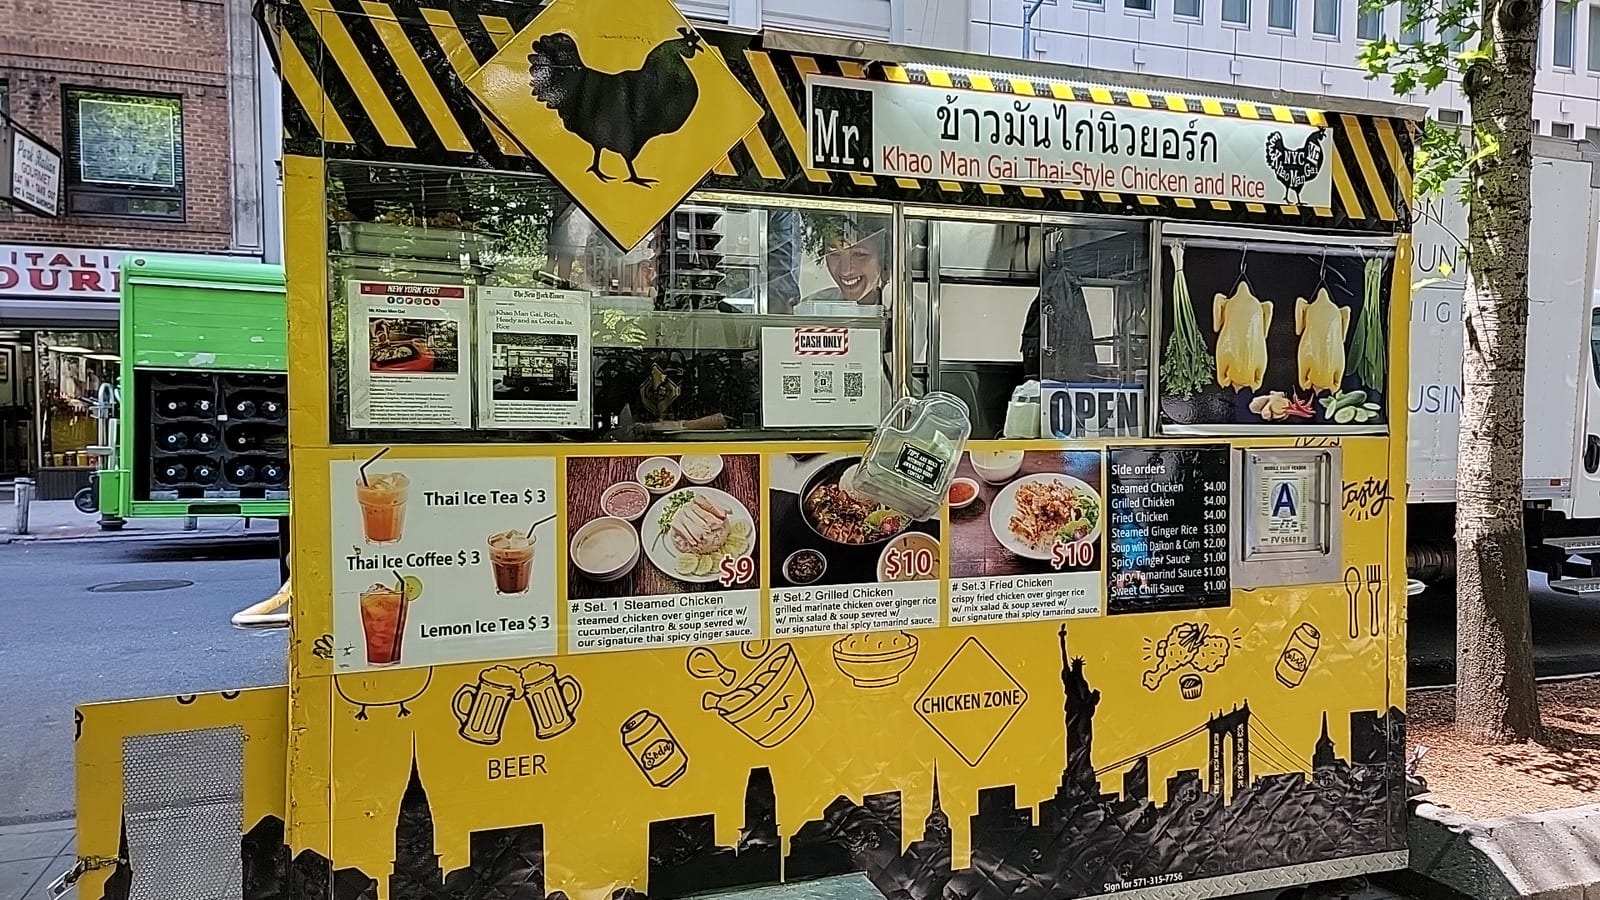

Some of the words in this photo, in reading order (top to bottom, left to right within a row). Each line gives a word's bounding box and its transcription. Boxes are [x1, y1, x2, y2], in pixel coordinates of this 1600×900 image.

[937, 94, 1218, 163] ข้าวมันไก่นิวยอร์ก
[815, 108, 870, 169] Mr.
[1284, 150, 1305, 166] NYC
[883, 146, 932, 174] Khao
[941, 151, 979, 177] Man
[988, 155, 1017, 179] Gai
[1025, 157, 1115, 191] Thai-Style
[1121, 165, 1188, 193] Chicken
[1194, 172, 1225, 195] and
[1232, 174, 1265, 198] Rice
[1290, 169, 1306, 187] Man
[1304, 163, 1318, 177] Gai
[11, 251, 120, 269] ITALI
[0, 266, 120, 292] OUR
[387, 285, 403, 293] NEW
[404, 286, 421, 294] YORK
[423, 287, 440, 295] POST
[514, 290, 524, 298] The
[524, 290, 535, 298] New
[536, 291, 549, 299] York
[800, 335, 821, 348] CASH
[823, 335, 842, 348] ONLY
[1050, 390, 1138, 438] OPEN
[907, 449, 920, 458] TIPS
[1111, 463, 1132, 475] Side
[1134, 463, 1166, 475] orders
[1111, 483, 1149, 494] Steamed
[1150, 482, 1184, 493] Chicken
[1203, 481, 1226, 491] $4.00
[423, 492, 459, 506] Thai
[464, 491, 487, 505] Ice
[490, 490, 518, 505] Tea
[1111, 497, 1140, 509] Grilled
[1142, 496, 1175, 508] Chicken
[1203, 495, 1226, 506] $4.00
[1272, 483, 1296, 517] A
[1112, 512, 1133, 523] Fried
[1135, 511, 1168, 523] Chicken
[1203, 510, 1226, 520] $4.00
[1111, 526, 1149, 538] Steamed
[1151, 526, 1178, 539] Ginger
[1181, 525, 1198, 535] Rice
[1203, 524, 1226, 534] $3.00
[1052, 541, 1092, 569] $10
[1111, 543, 1130, 554] Soup
[1131, 542, 1148, 552] with
[1149, 541, 1174, 551] Daikon
[1175, 540, 1182, 549] &
[1183, 539, 1201, 550] Corn
[1203, 538, 1226, 548] $2.00
[346, 555, 378, 570] Thai
[383, 555, 403, 568] Ice
[407, 553, 453, 567] Coffee
[886, 549, 931, 578] $10
[1111, 556, 1134, 569] Spicy
[1136, 555, 1164, 568] Ginger
[1166, 554, 1190, 565] Sauce
[1203, 552, 1226, 562] $1.00
[721, 556, 753, 584] $9
[1111, 571, 1134, 585] Spicy
[1136, 568, 1175, 580] Tamarind
[1178, 568, 1202, 578] Sauce
[1203, 566, 1226, 577] $1.00
[952, 582, 958, 591] #
[962, 581, 985, 591] Set.3
[990, 580, 1013, 589] Fried
[1016, 578, 1053, 588] Chicken
[1111, 585, 1137, 597] Sweet
[1139, 583, 1158, 595] Chili
[1160, 583, 1185, 593] Sauce
[1203, 580, 1226, 591] $1.00
[571, 603, 579, 613] #
[624, 597, 675, 610] Steamed
[680, 596, 723, 606] Chicken
[773, 593, 780, 603] #
[784, 591, 811, 602] Set.2
[815, 589, 849, 600] Grilled
[852, 588, 893, 598] Chicken
[952, 595, 974, 604] crispy
[977, 593, 994, 601] fried
[997, 592, 1025, 601] chicken
[1045, 589, 1069, 599] ginger
[1071, 588, 1085, 596] rice
[577, 614, 619, 625] steamed
[622, 613, 659, 622] chicken
[661, 612, 682, 620] over
[685, 610, 714, 621] ginger
[717, 608, 733, 616] rice
[736, 606, 747, 615] w/
[775, 604, 802, 616] grilled
[805, 602, 841, 611] marinate
[843, 601, 873, 610] chicken
[895, 598, 920, 608] ginger
[421, 621, 471, 638] Lemon
[476, 620, 496, 634] Ice
[499, 618, 525, 632] Tea
[668, 622, 676, 631] &
[679, 622, 701, 631] soup
[736, 617, 747, 626] w/
[792, 624, 831, 635] signature
[833, 622, 848, 630] thai
[851, 620, 871, 630] spicy
[873, 617, 908, 627] tamarind
[910, 617, 935, 625] sauce.
[597, 636, 643, 648] signature
[646, 634, 664, 642] thai
[667, 632, 690, 643] spicy
[693, 630, 723, 640] ginger
[725, 628, 752, 637] sauce.
[922, 693, 981, 714] CHICKEN
[984, 689, 1020, 708] ZONE
[646, 742, 672, 768] Soda
[488, 754, 548, 779] BEER
[1104, 883, 1120, 893] Sign
[1121, 880, 1132, 889] for
[1133, 872, 1183, 887] 571-315-7756
